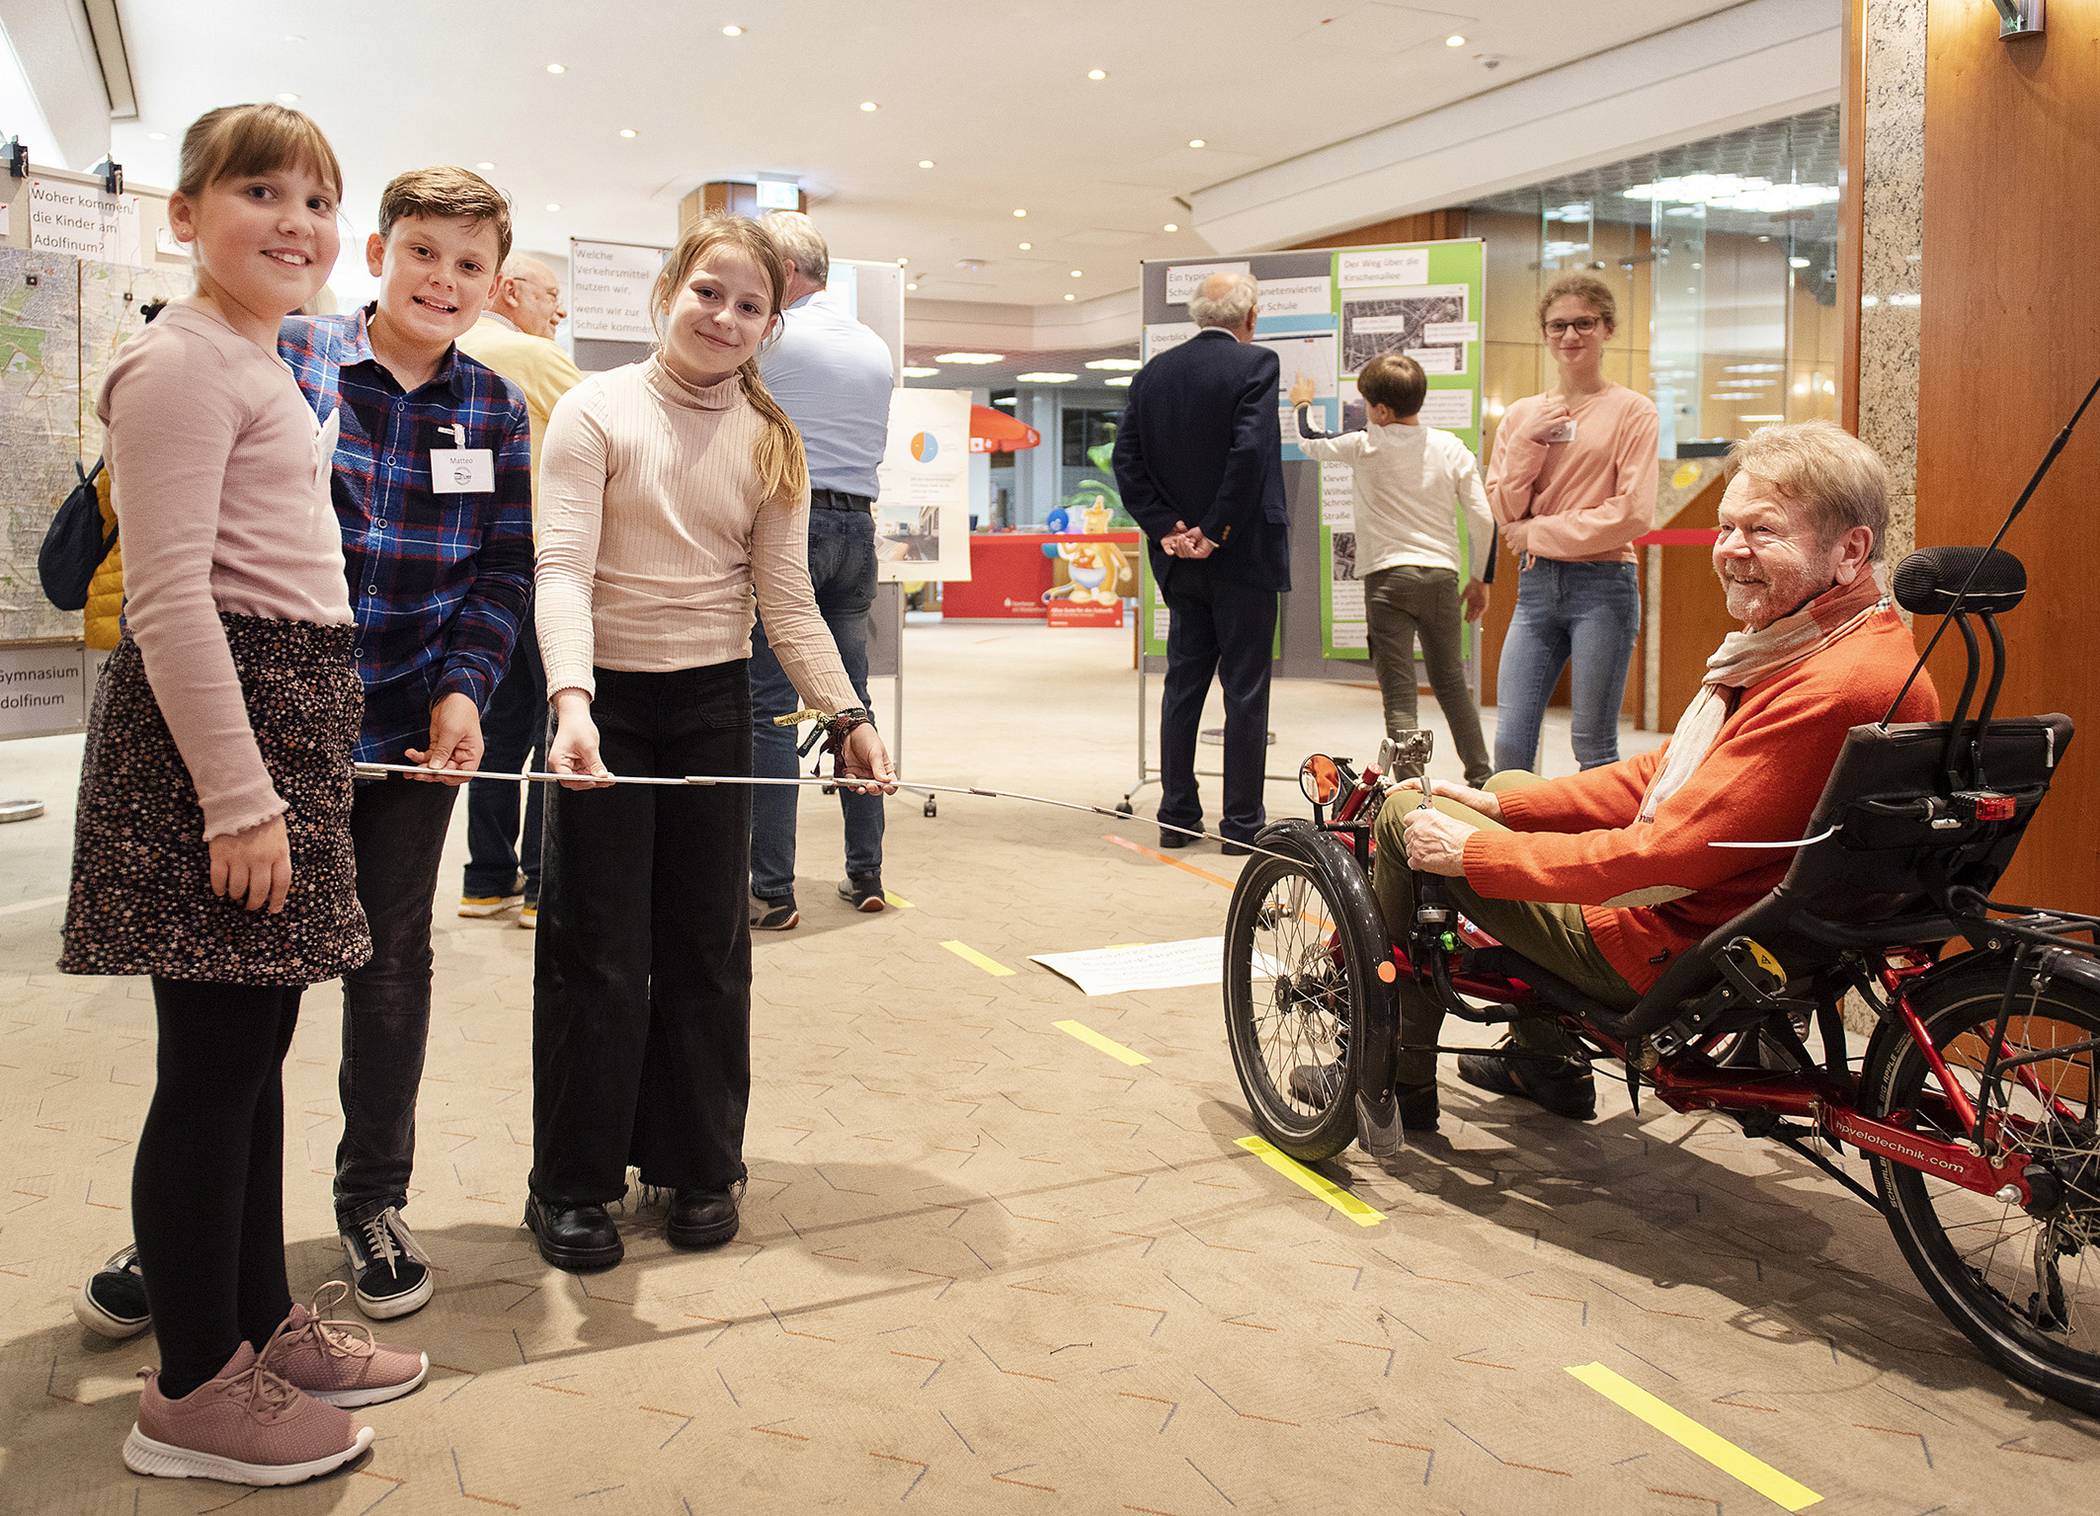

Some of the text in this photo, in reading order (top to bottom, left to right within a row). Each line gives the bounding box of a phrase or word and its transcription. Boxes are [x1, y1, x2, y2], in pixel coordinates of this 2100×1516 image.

[31, 188, 74, 205] Woher
[33, 211, 118, 234] die Kinder am
[34, 234, 105, 253] Adolfinum?
[575, 249, 613, 260] Welche
[575, 265, 650, 279] Verkehrsmittel
[1169, 273, 1183, 282] Ein
[575, 282, 610, 292] nutzen
[575, 305, 640, 317] wenn wir zur
[1267, 300, 1298, 311] Schule
[575, 320, 608, 331] Schule
[0, 693, 65, 710] dolfinum
[1836, 1120, 1965, 1175] hpvelotechnik.com
